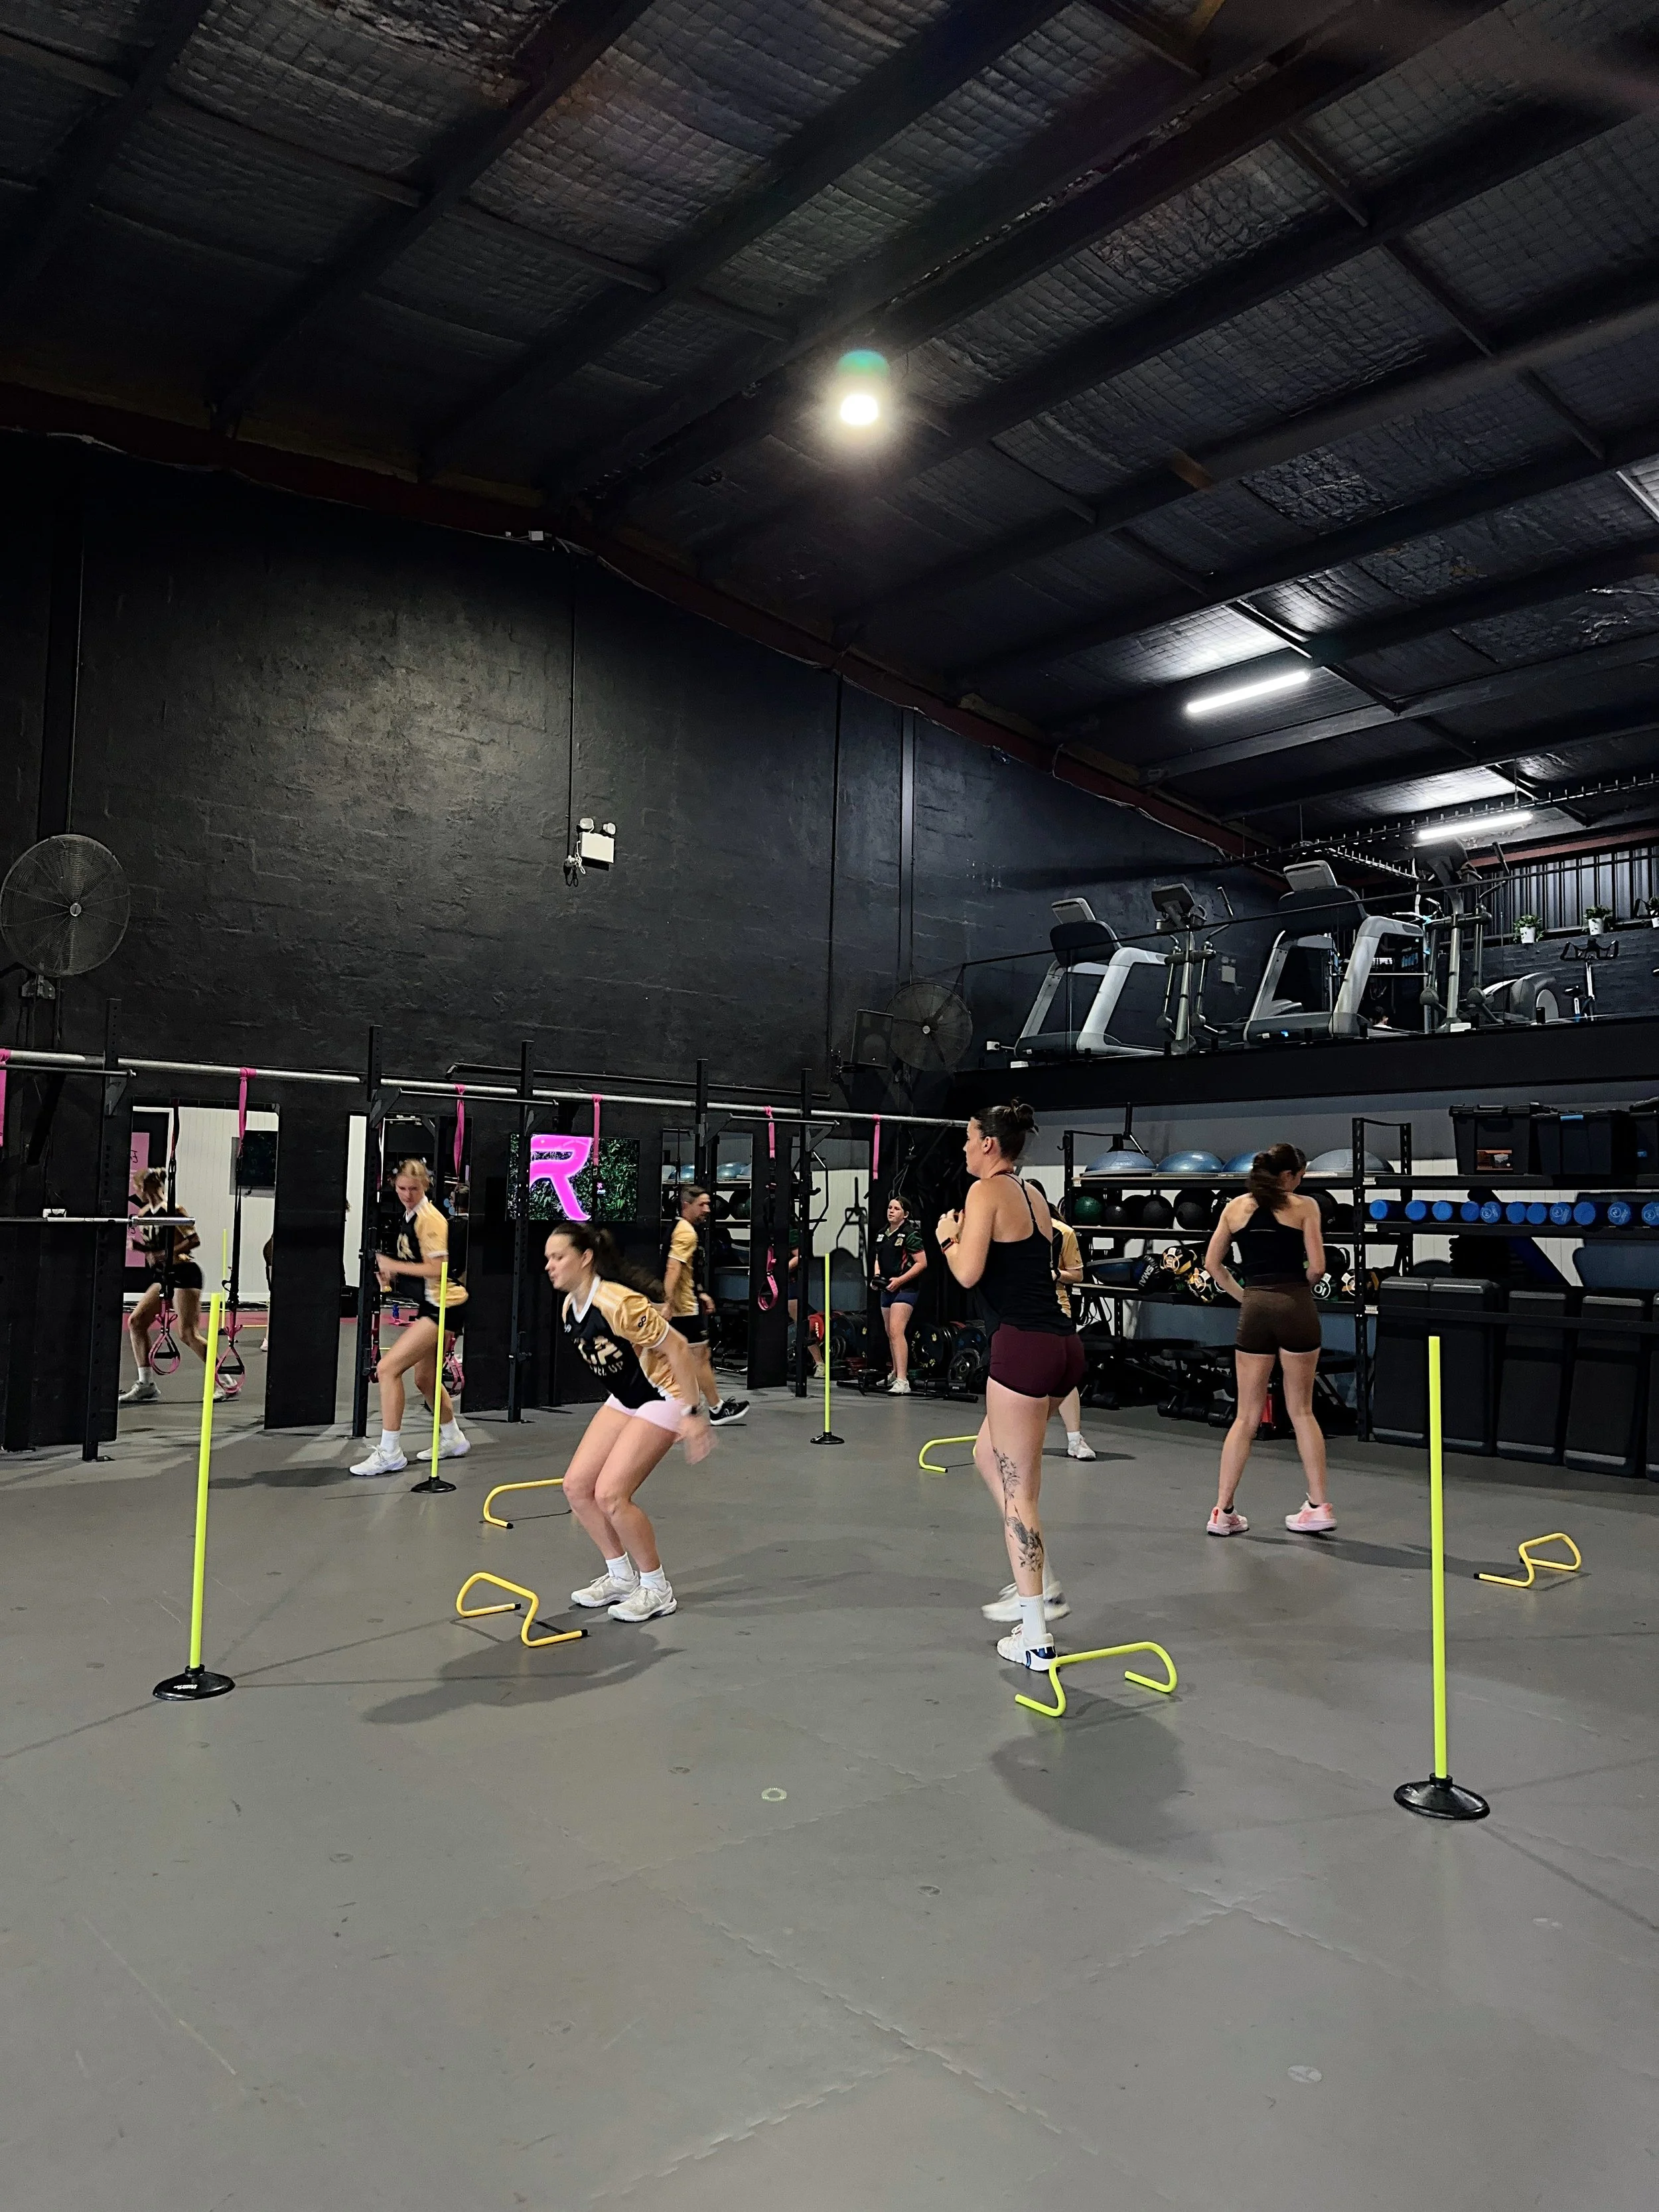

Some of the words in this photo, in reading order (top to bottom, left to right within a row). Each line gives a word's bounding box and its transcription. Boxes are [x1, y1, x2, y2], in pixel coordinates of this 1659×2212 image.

[529, 1134, 592, 1221] R
[1139, 1265, 1154, 1287] SMAI
[1314, 1284, 1327, 1295] 10
[608, 1361, 624, 1373] UP
